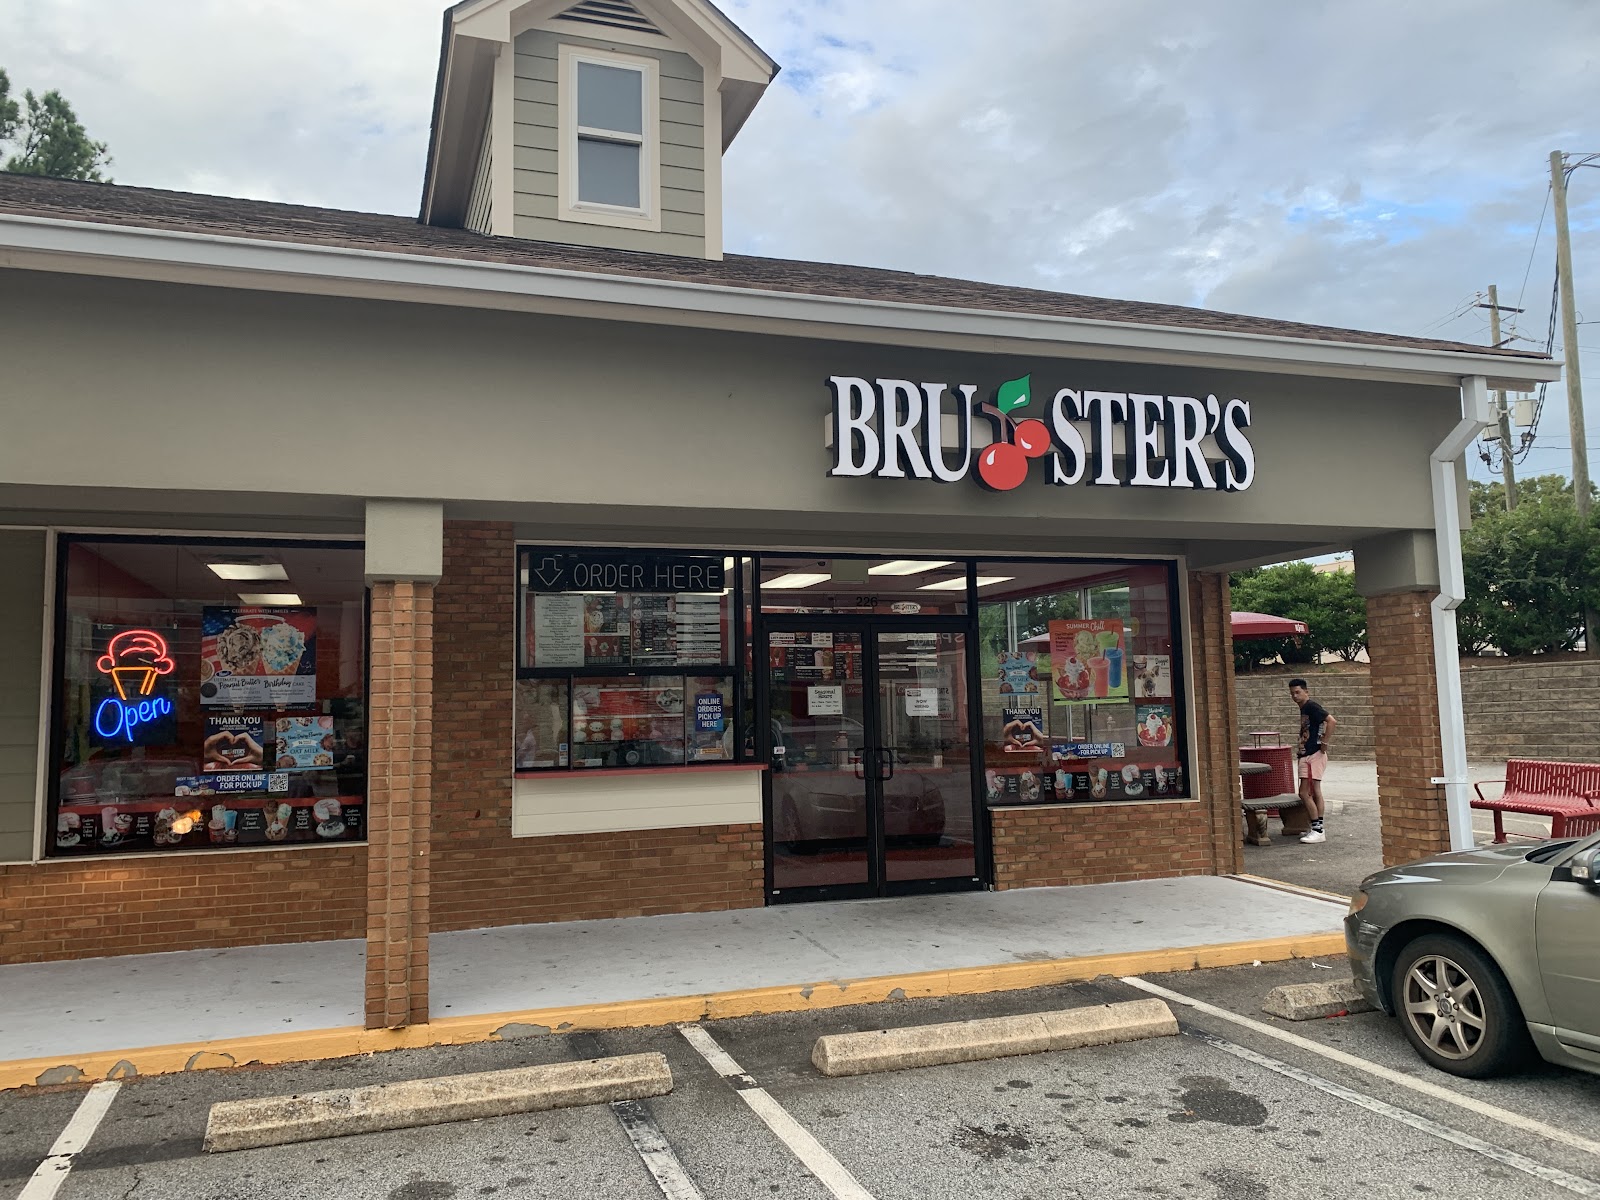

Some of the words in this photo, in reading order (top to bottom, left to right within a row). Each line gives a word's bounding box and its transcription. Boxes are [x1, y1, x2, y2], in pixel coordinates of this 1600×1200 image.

[574, 563, 644, 588] ORDER
[655, 565, 720, 589] HERE
[856, 596, 878, 608] 226
[1090, 620, 1105, 632] Chill
[264, 677, 291, 689] Birthday
[697, 705, 722, 713] ORDERS
[95, 697, 171, 742] Open
[208, 717, 241, 725] THANK
[242, 716, 261, 725] YOU
[216, 775, 241, 783] ORDER
[241, 773, 266, 782] ONLINE
[219, 781, 234, 789] FOR
[234, 781, 252, 789] PICK
